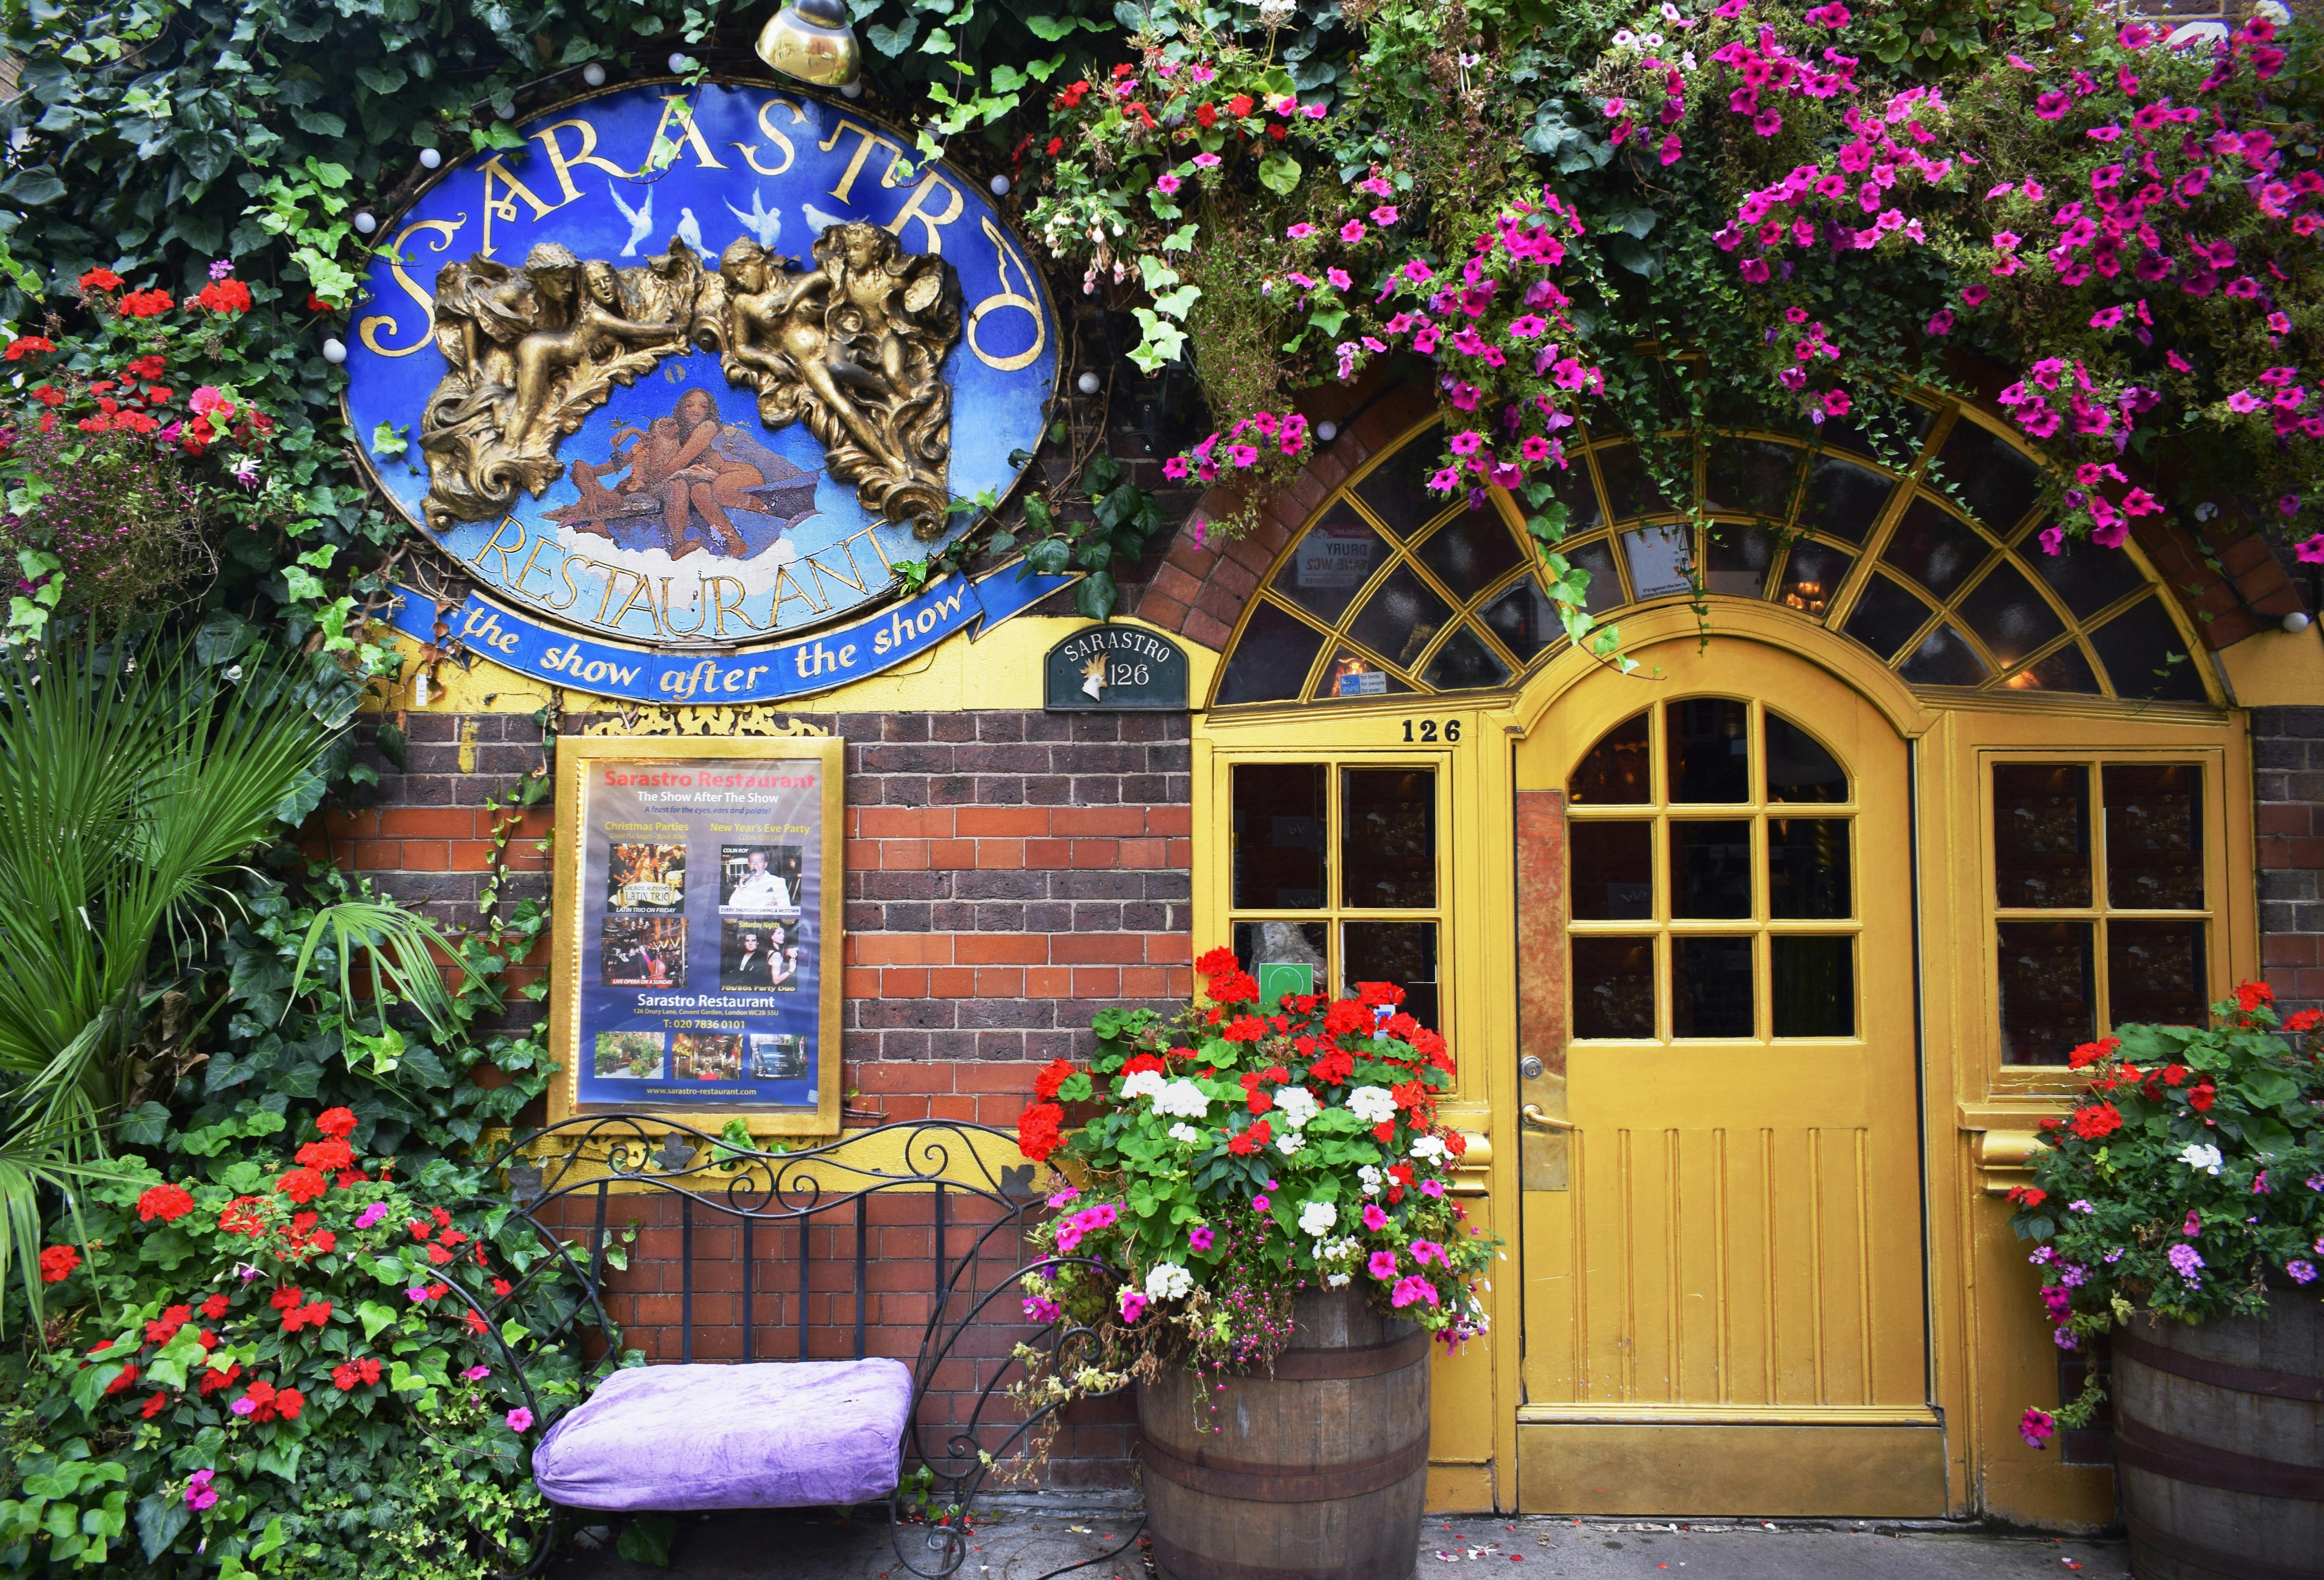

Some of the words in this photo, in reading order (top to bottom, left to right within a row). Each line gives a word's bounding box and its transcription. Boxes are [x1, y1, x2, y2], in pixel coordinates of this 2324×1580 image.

[359, 94, 1046, 371] SARASTRO
[468, 514, 899, 637] RESTAURANT
[461, 607, 521, 656] the
[540, 637, 642, 689] show
[659, 660, 768, 701] after
[794, 630, 858, 679] the
[873, 585, 966, 656] show
[1064, 632, 1170, 663] SARASTRO
[1110, 664, 1149, 685] 126
[1402, 719, 1460, 742] 126
[604, 770, 692, 787] Sarastro
[698, 771, 815, 788] Restaurant
[637, 791, 658, 801] The
[660, 791, 691, 802] Show
[694, 791, 722, 802] After
[724, 792, 745, 802] The
[747, 792, 779, 803] Show
[605, 822, 653, 831] Christmas
[655, 822, 689, 831] Parties
[710, 823, 732, 832] New
[734, 824, 762, 832] Year's
[764, 824, 781, 833] Eve
[784, 824, 810, 835] Party
[625, 892, 648, 901] LATIN
[650, 892, 670, 901] TRIO
[638, 994, 695, 1007] Sarastro
[698, 995, 775, 1008] Restaurant
[663, 1019, 672, 1028] T:
[673, 1020, 692, 1029] 020
[694, 1020, 719, 1029] 7836
[721, 1020, 745, 1029] 0101
